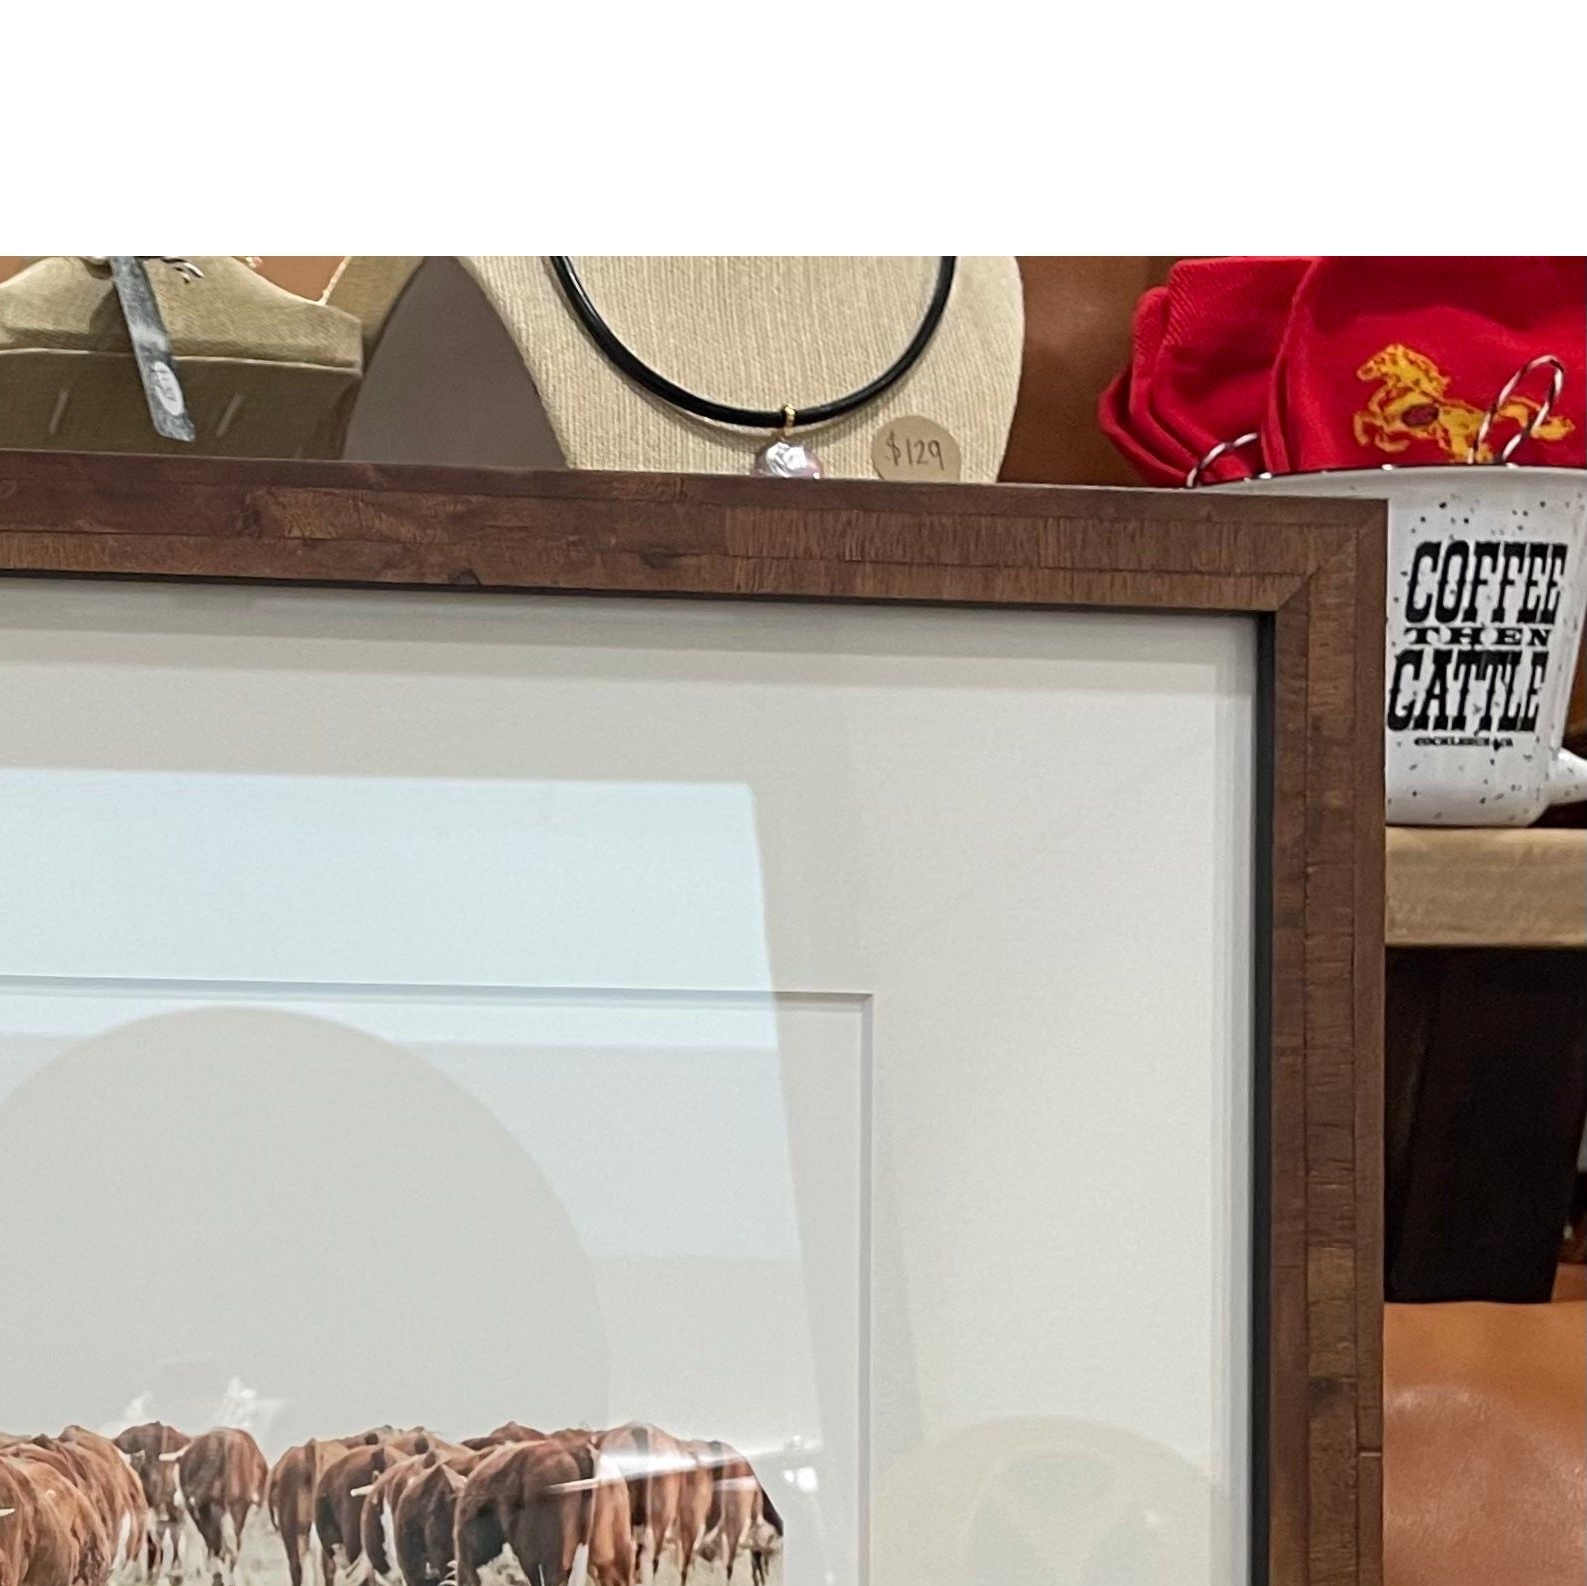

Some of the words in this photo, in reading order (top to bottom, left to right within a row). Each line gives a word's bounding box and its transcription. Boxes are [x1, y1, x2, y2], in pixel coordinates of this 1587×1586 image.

[885, 431, 945, 471] $129
[1404, 540, 1568, 625] COFFEE
[1403, 626, 1552, 647] THEN
[1386, 647, 1550, 732] CATTLE
